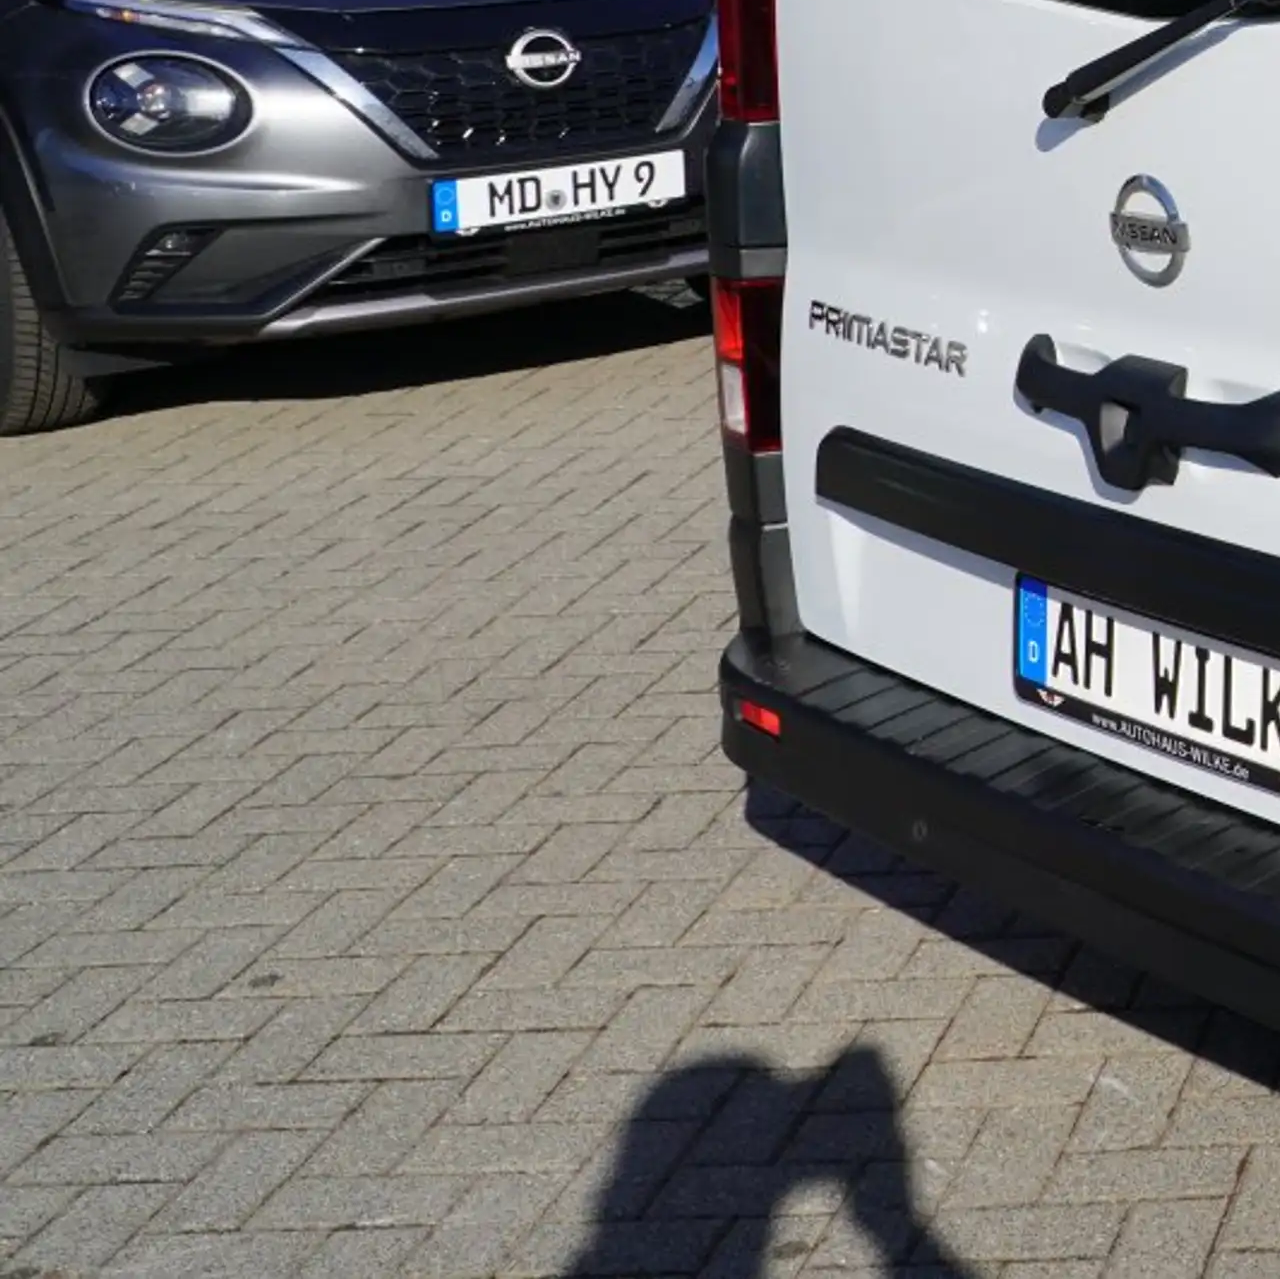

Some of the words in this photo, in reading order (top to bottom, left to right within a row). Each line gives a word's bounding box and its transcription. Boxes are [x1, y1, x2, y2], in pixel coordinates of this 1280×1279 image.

[441, 207, 452, 223] D
[488, 176, 541, 218] MD
[571, 165, 622, 207] HY
[633, 160, 656, 198] 9
[808, 299, 968, 378] PRIMASTAR
[1027, 639, 1040, 664] D
[1052, 602, 1115, 697] AH
[1092, 713, 1250, 779] www.AUTOHAUS-WILKE.de
